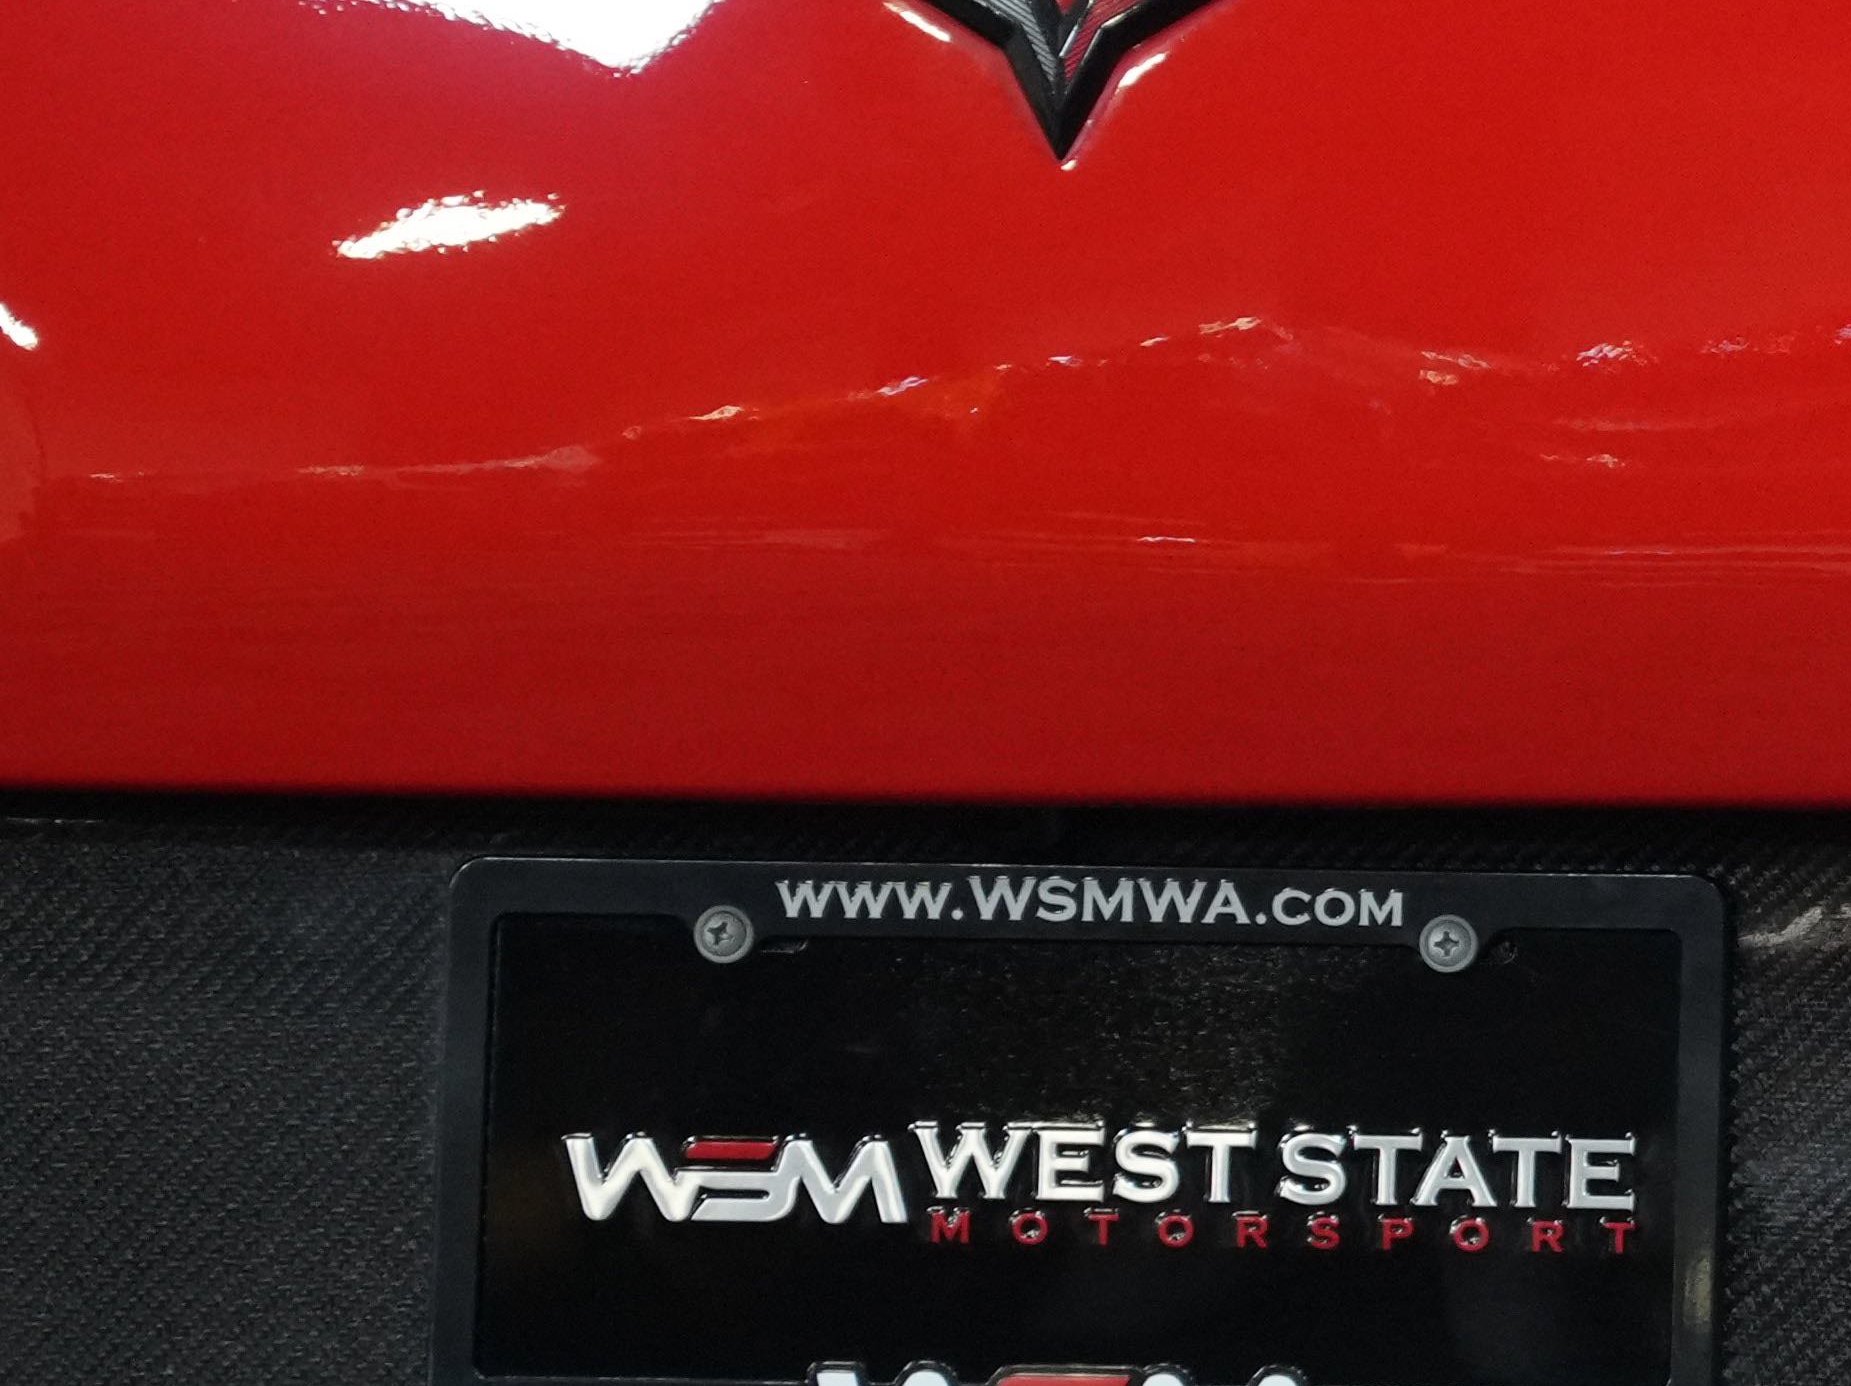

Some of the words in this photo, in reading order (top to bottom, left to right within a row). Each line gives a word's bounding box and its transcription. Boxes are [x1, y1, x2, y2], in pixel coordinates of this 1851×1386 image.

[914, 1119, 1258, 1204] WEST
[1277, 1125, 1637, 1211] STATE
[930, 1211, 1636, 1254] MOTORSPORT
